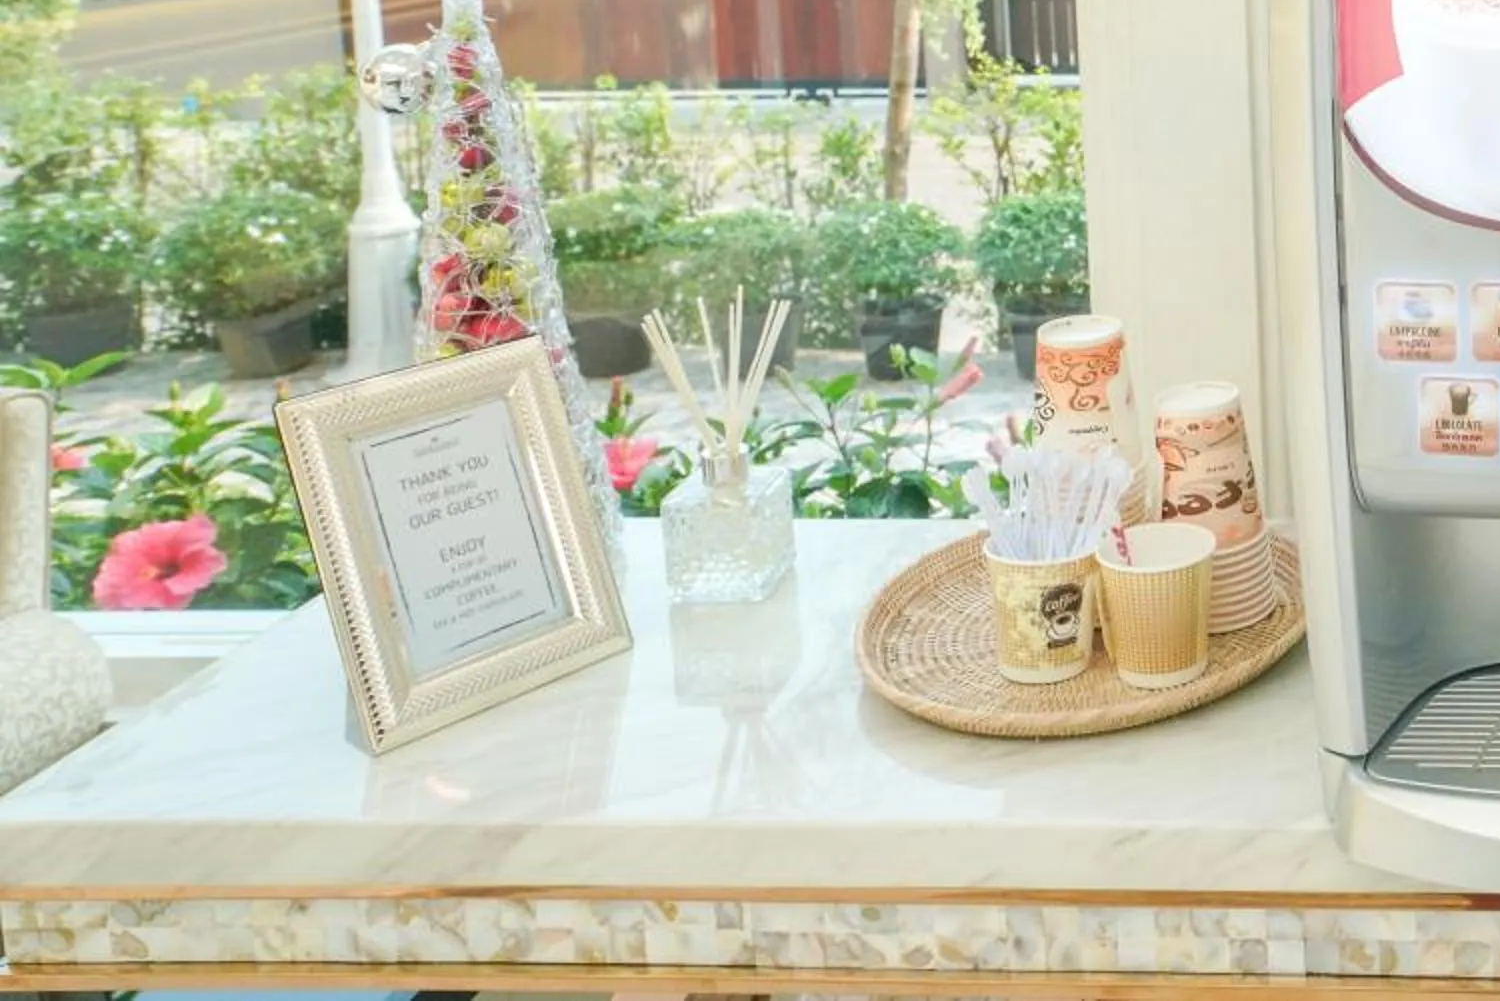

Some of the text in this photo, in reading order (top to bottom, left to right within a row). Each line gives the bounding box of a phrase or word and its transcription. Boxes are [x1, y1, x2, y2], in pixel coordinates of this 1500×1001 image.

[399, 453, 488, 492] THANK YOU
[409, 507, 443, 530] OUR
[439, 535, 486, 563] ENJOY
